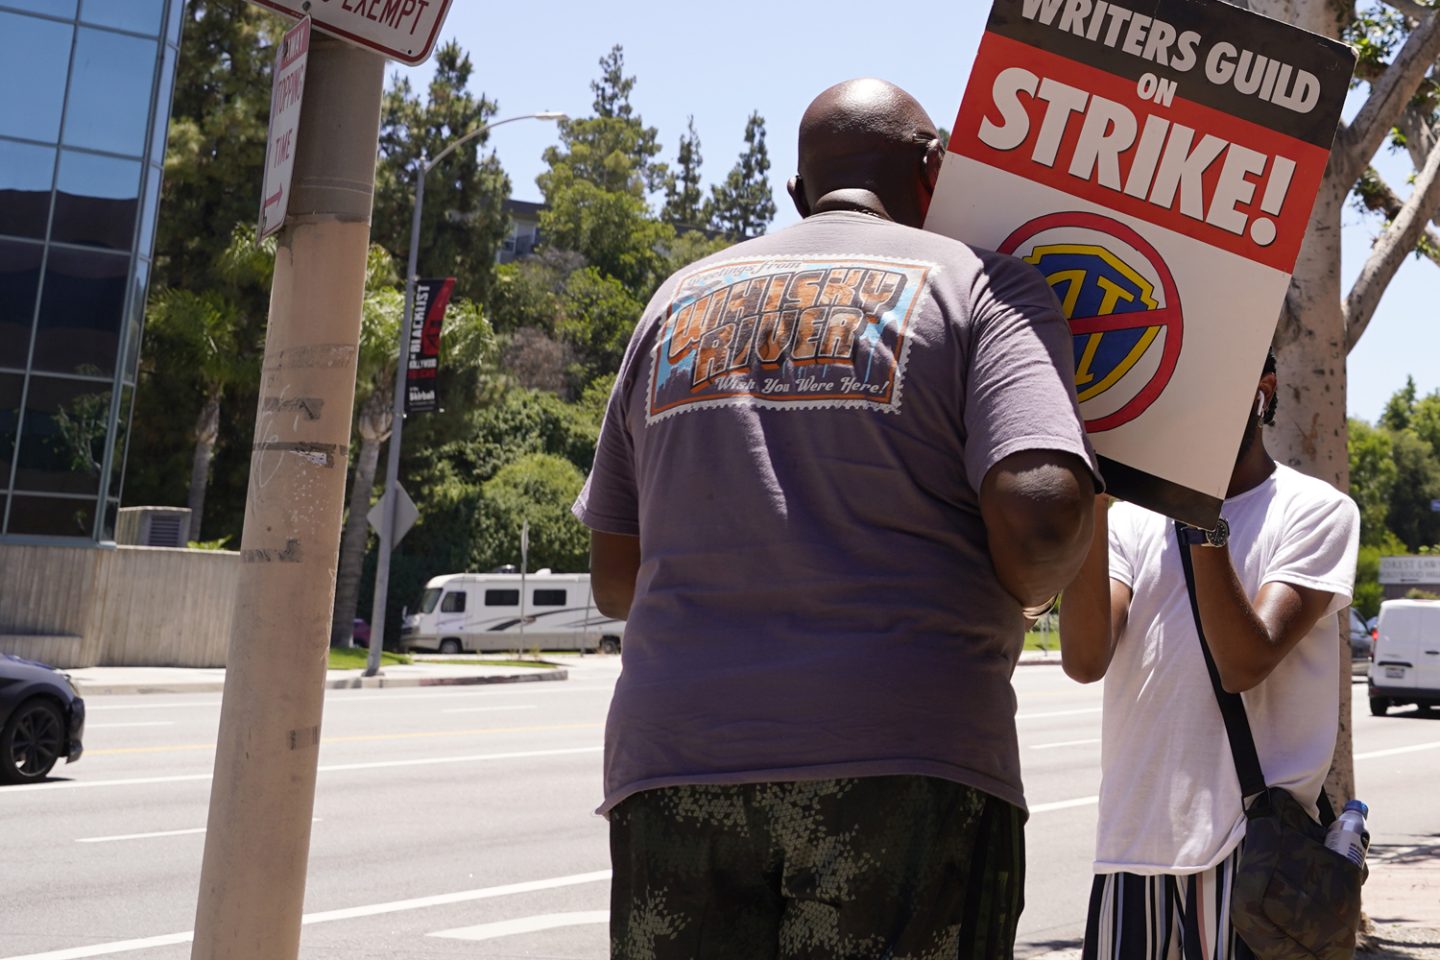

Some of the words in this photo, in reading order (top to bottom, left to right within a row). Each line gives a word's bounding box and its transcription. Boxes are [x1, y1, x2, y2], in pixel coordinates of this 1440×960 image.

[1136, 73, 1178, 108] ON
[1205, 41, 1322, 115] GUILD
[977, 67, 1298, 247] STRIKE!
[410, 285, 431, 354] BLACKLIST
[668, 267, 906, 360] WHISKY
[692, 305, 866, 387] RIVER
[715, 376, 757, 391] Wish
[762, 377, 791, 394] You
[796, 376, 834, 393] Were
[840, 376, 890, 395] Here!
